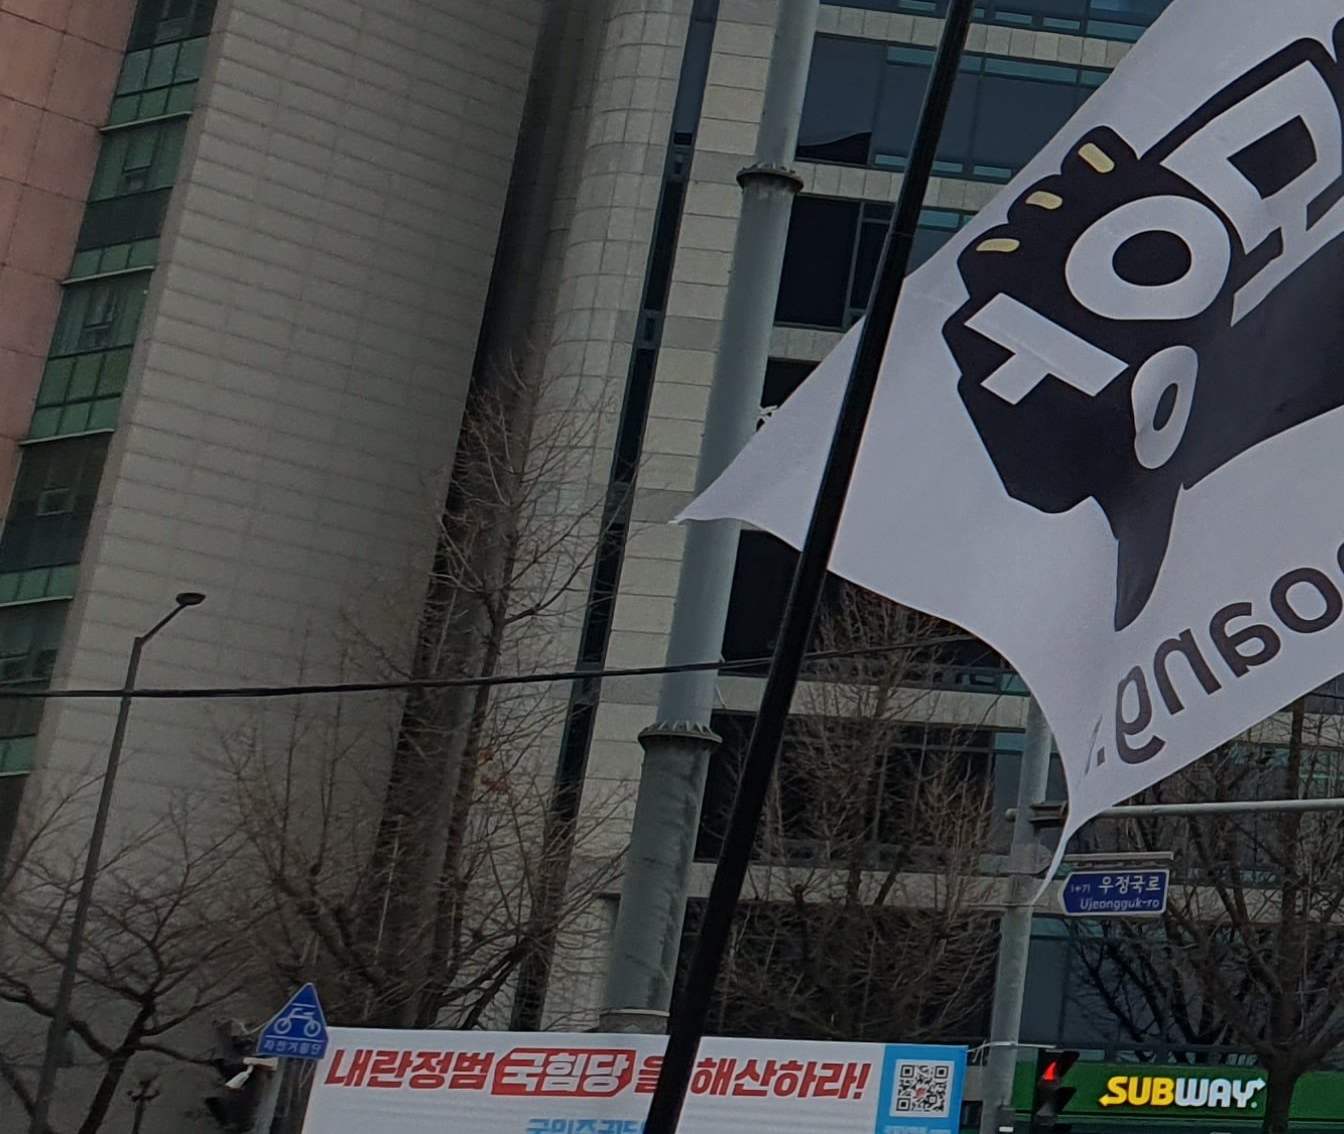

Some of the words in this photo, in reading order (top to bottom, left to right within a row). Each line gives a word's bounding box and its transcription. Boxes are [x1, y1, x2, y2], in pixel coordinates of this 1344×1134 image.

[1098, 875, 1161, 894] 우정국로
[1080, 897, 1160, 911] Ujeongguk-ro
[324, 1046, 496, 1091] 내란정범
[690, 1056, 873, 1100] 해산하라!
[1098, 1074, 1268, 1110] SUBWAY
